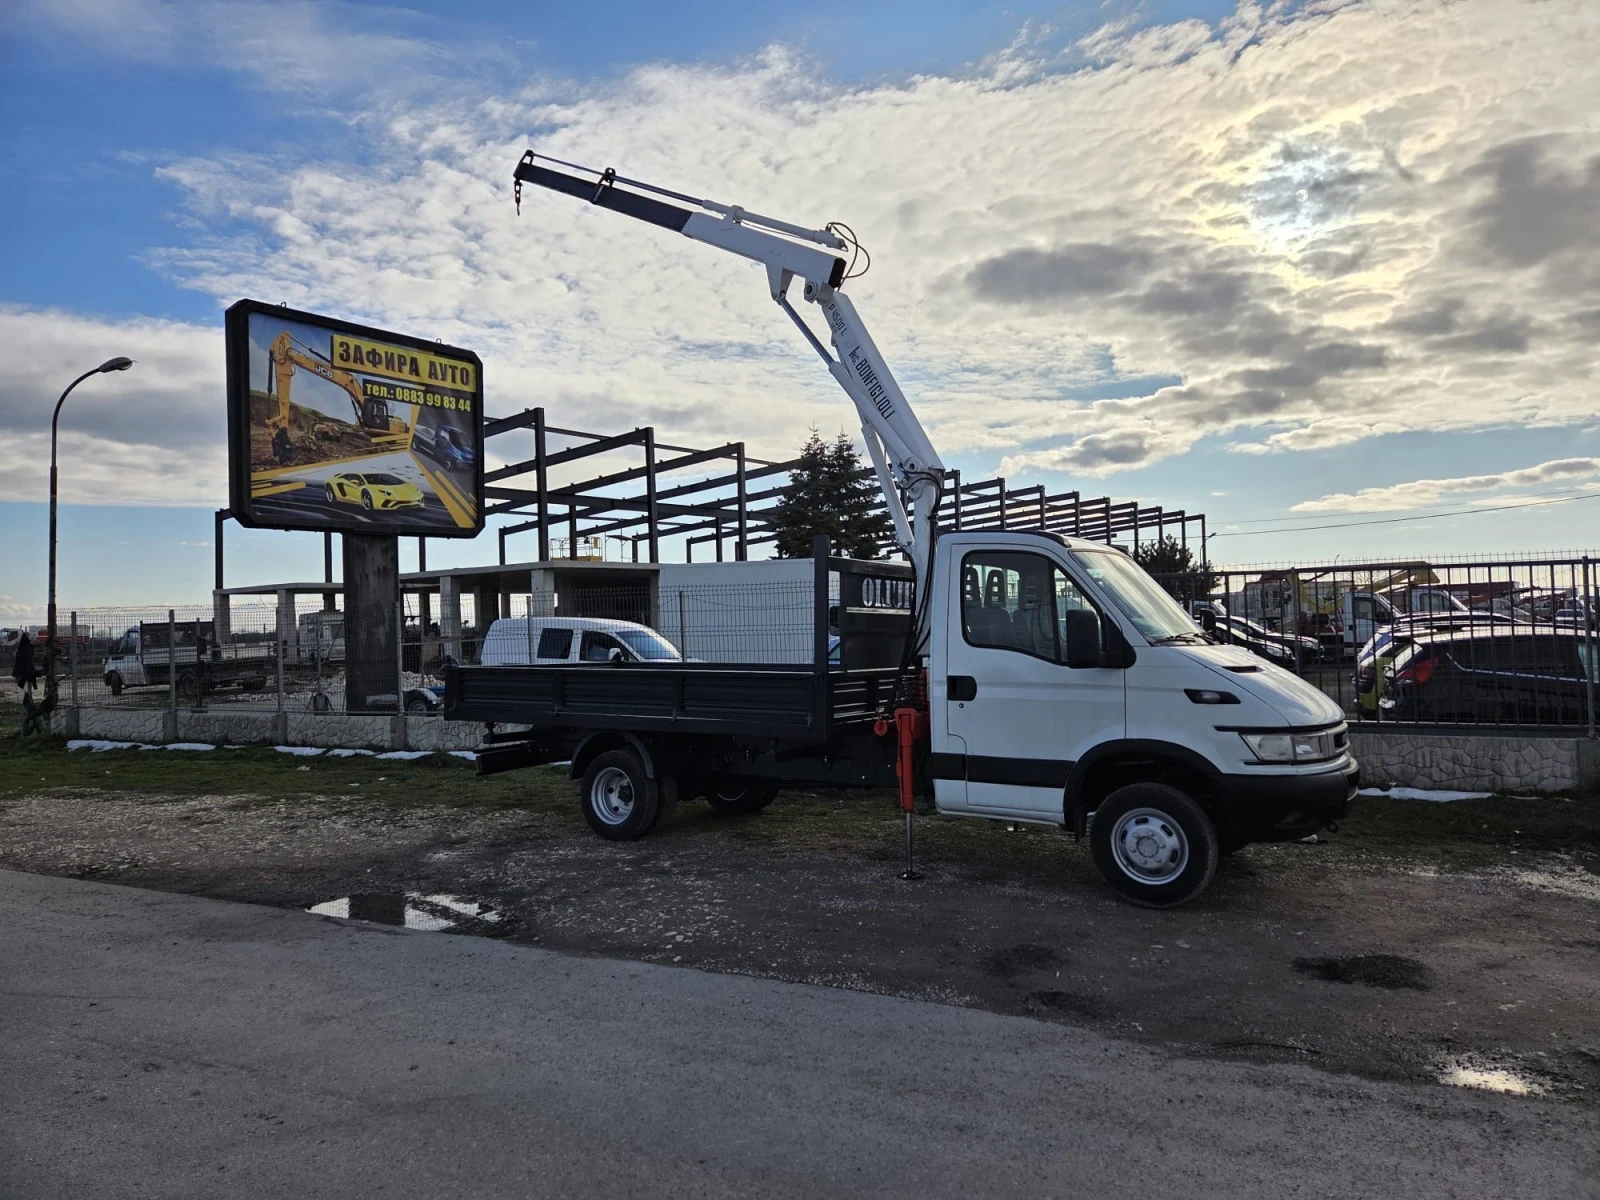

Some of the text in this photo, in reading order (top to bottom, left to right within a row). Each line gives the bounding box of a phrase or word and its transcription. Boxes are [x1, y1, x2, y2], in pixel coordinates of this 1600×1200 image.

[828, 303, 848, 336] P 4500 L
[314, 365, 334, 379] JCB
[339, 341, 470, 386] ЗАФИРА АУТО
[396, 389, 424, 404] 0883
[427, 393, 441, 407] 99
[443, 395, 456, 410] 83
[458, 399, 471, 413] 44
[855, 358, 896, 420] BONFIGLIOLI
